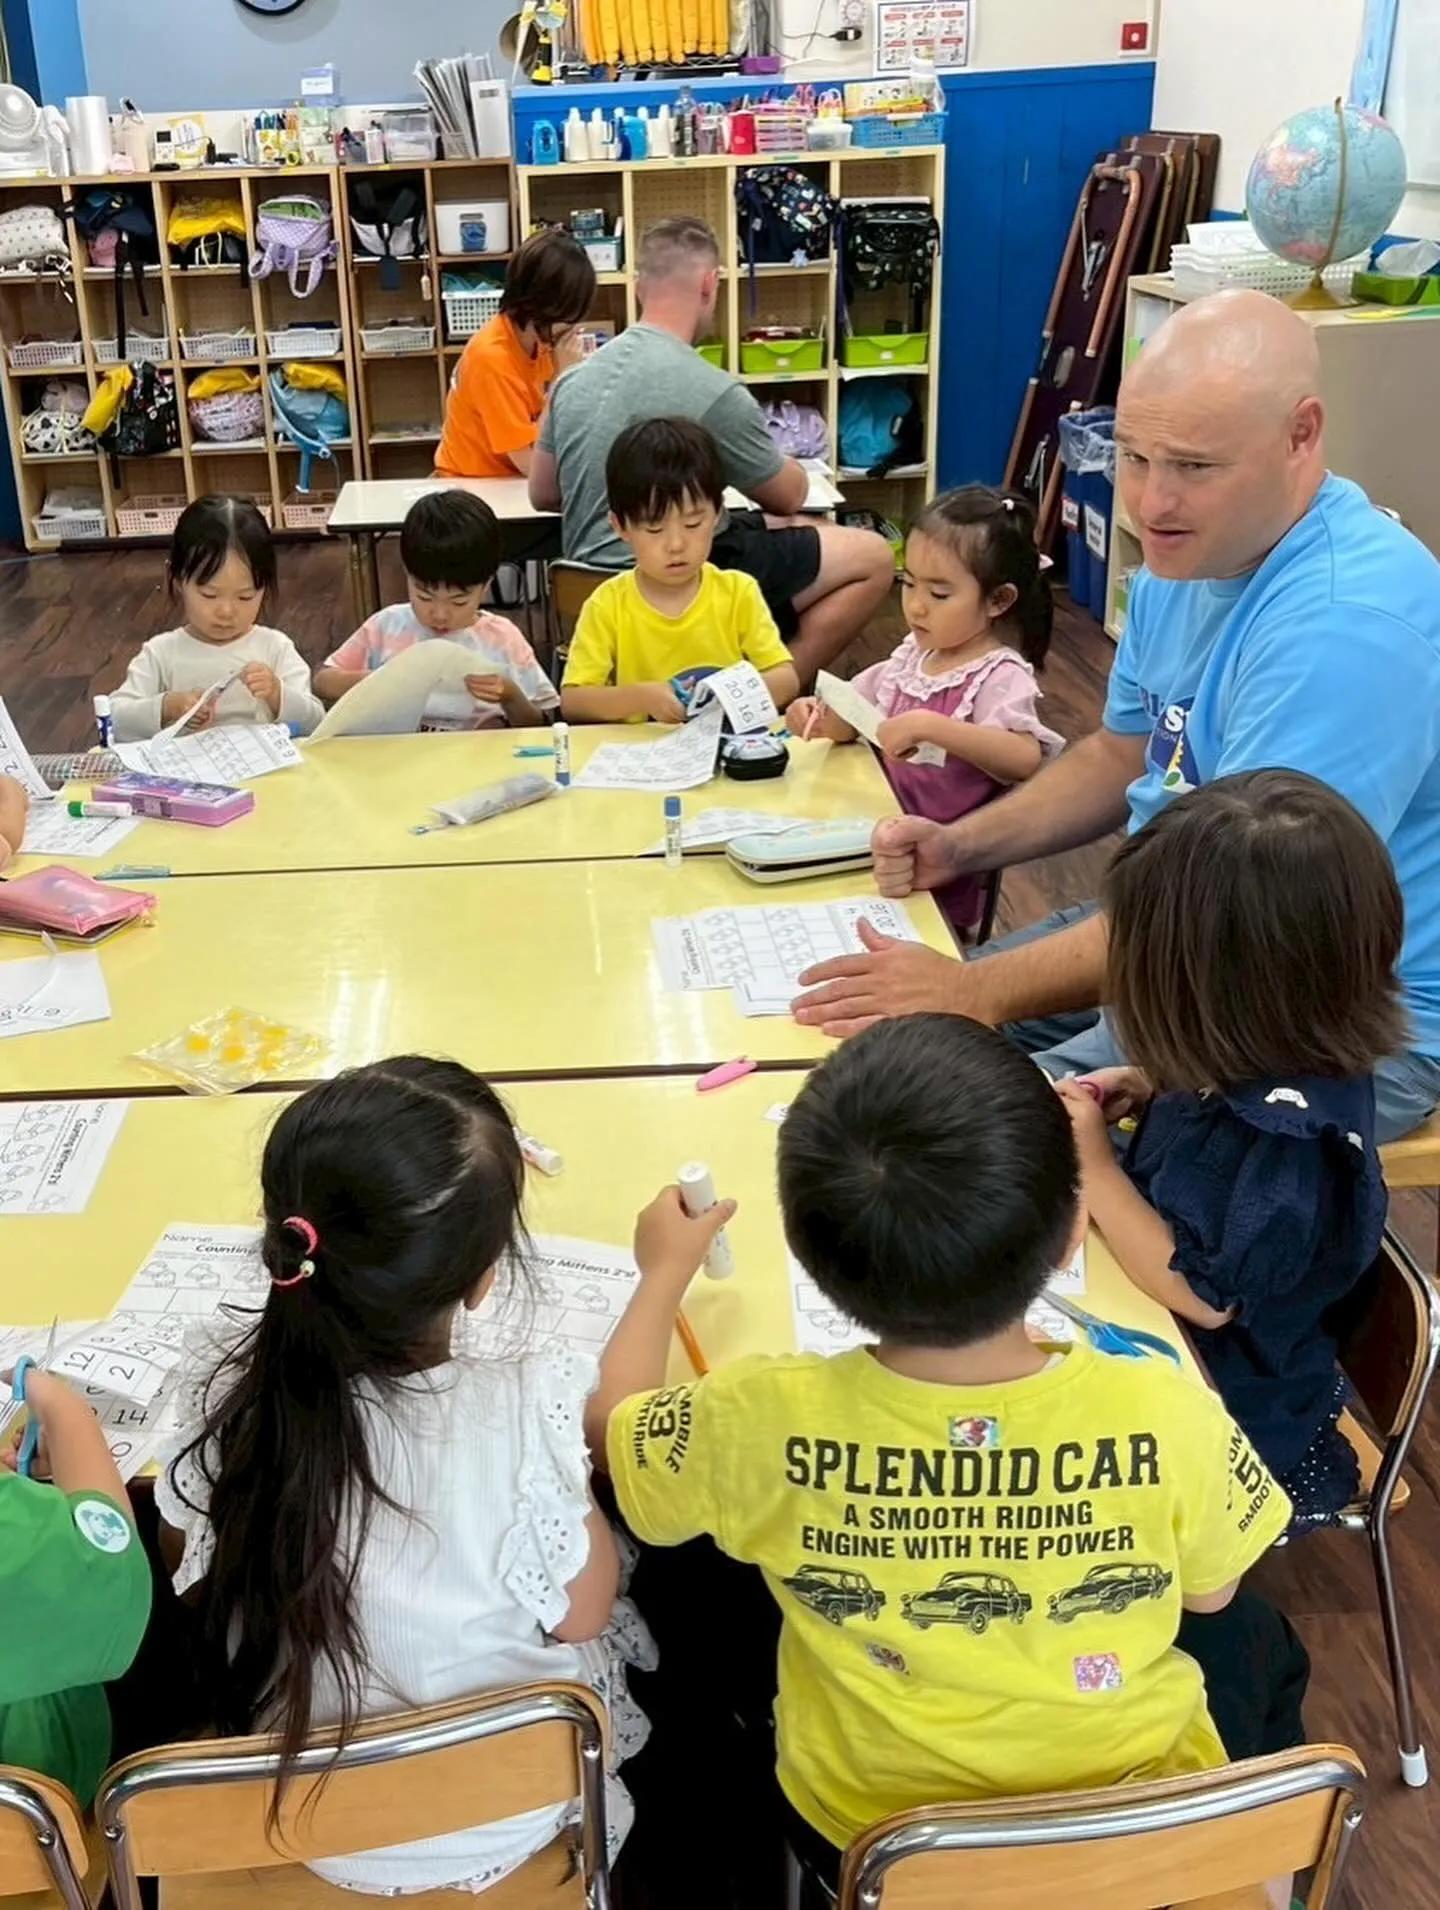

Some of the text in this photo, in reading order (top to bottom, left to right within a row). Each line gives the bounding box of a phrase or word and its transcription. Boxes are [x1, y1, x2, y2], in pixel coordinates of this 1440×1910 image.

[112, 1408, 149, 1426] 14
[785, 1435, 1040, 1498] SPLENDID
[1053, 1431, 1160, 1494] CAR
[843, 1500, 1093, 1531] A SMOOTH RIDING
[802, 1525, 1135, 1560] ENGINE WITH THE POWER
